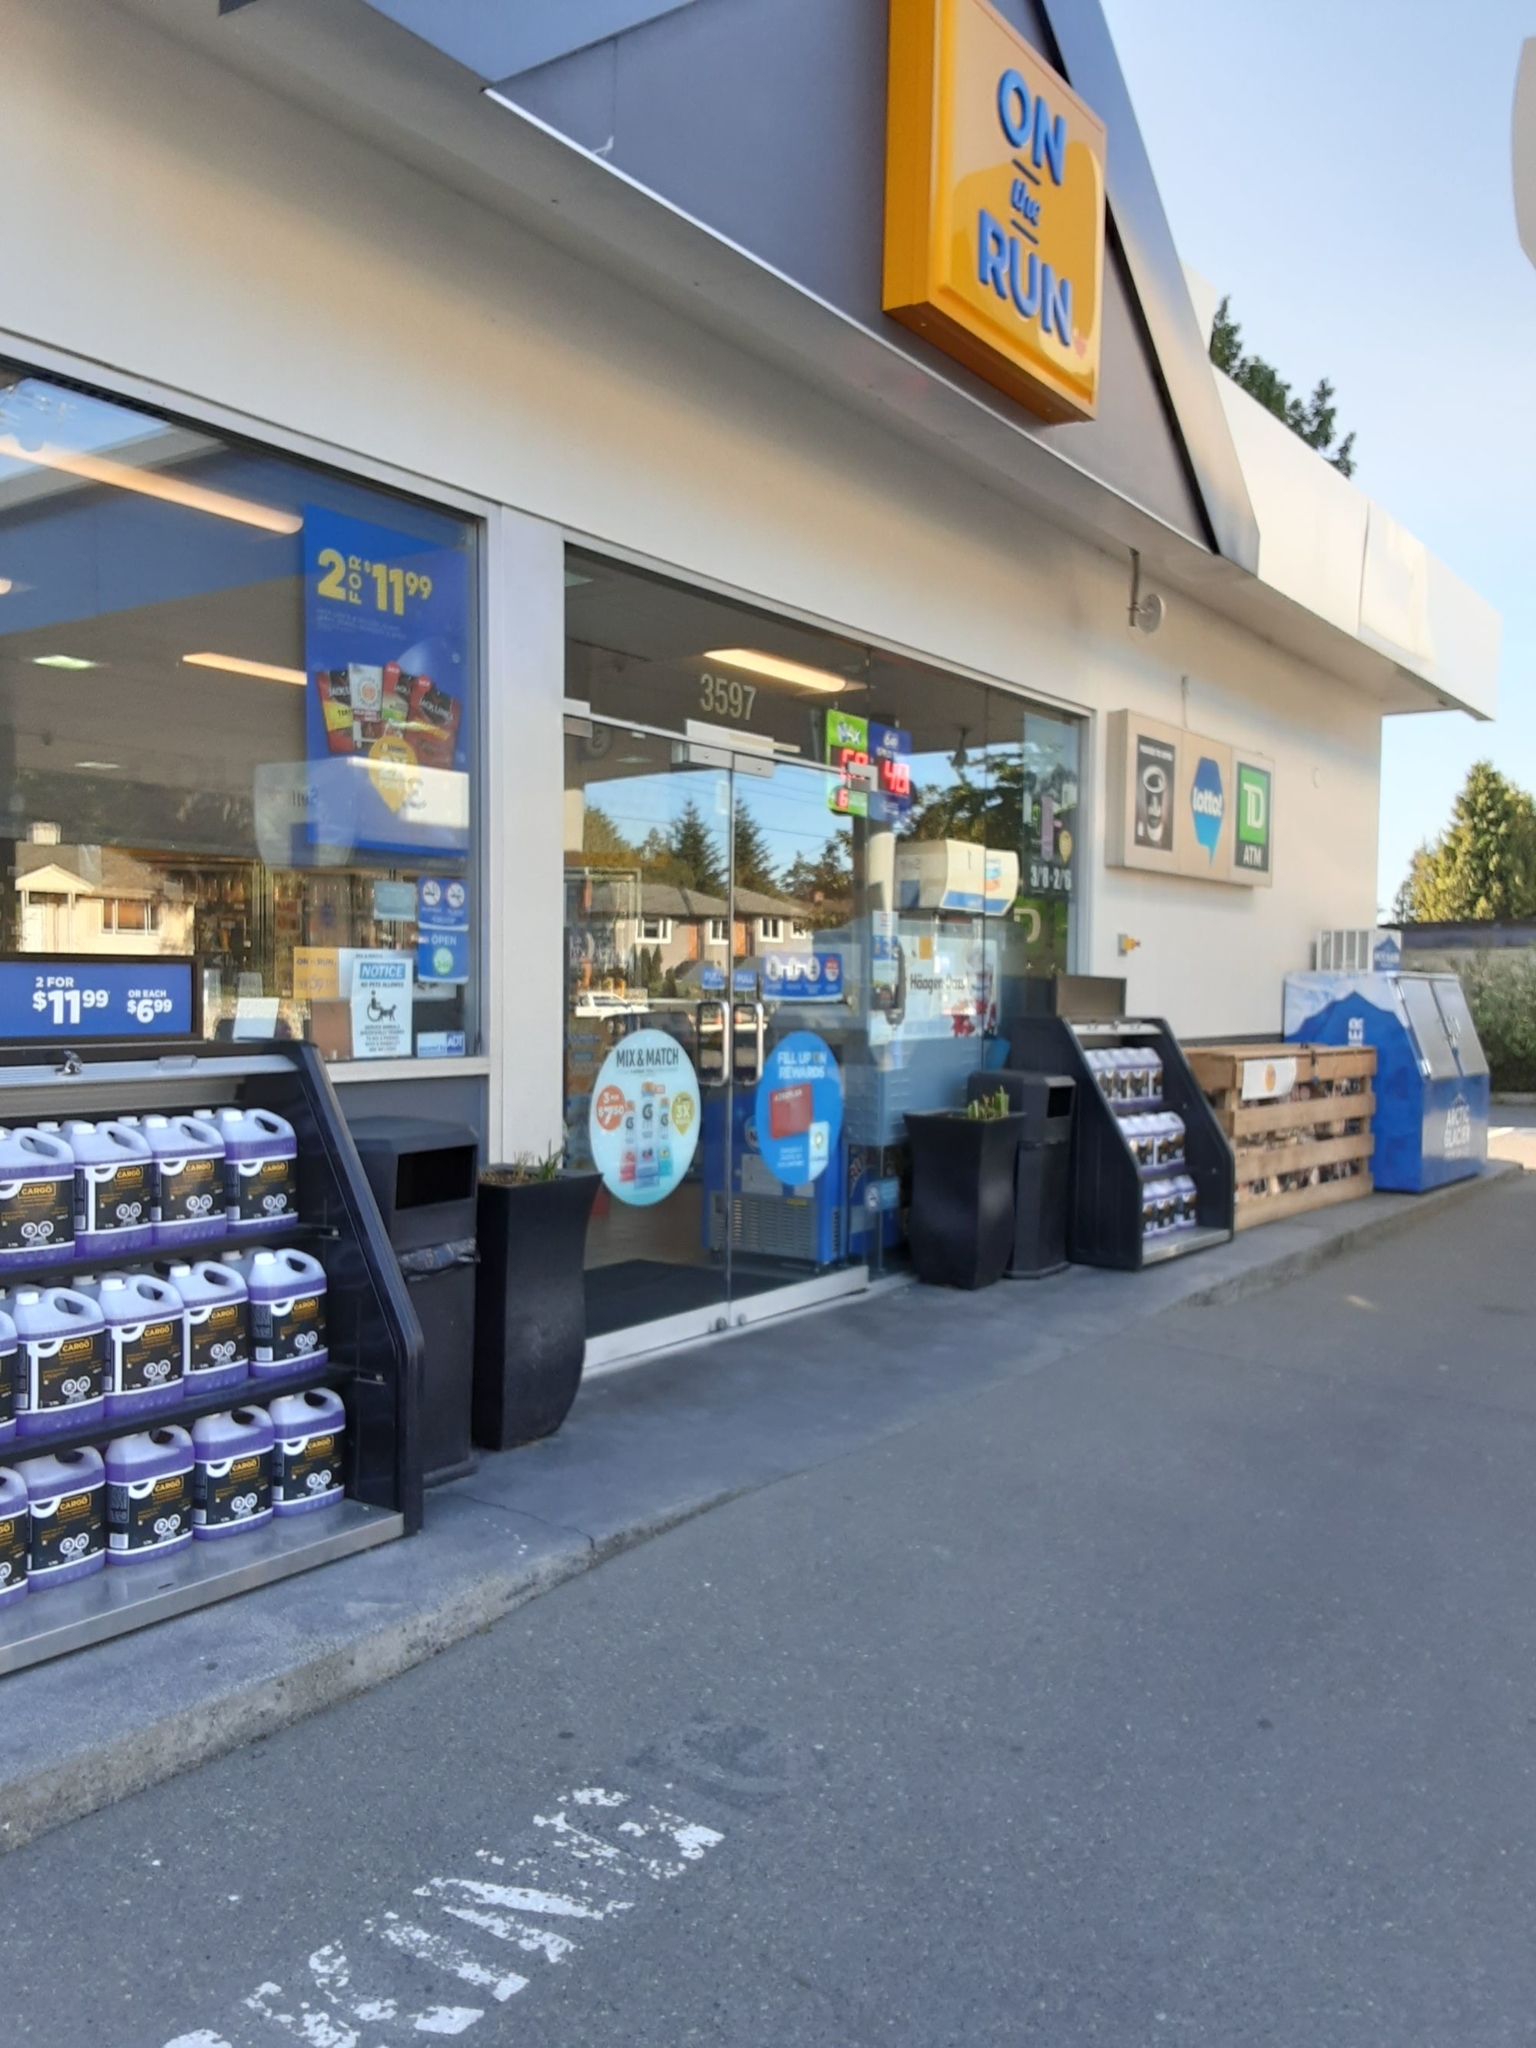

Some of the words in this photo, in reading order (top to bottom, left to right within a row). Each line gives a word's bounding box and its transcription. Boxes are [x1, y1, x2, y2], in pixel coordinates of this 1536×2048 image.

[997, 68, 1067, 186] ON
[1010, 178, 1040, 227] the
[978, 208, 1072, 347] RUN
[318, 548, 346, 601] 2
[348, 555, 362, 605] FOR
[700, 673, 756, 721] 3597
[1243, 782, 1264, 829] TD
[1243, 846, 1262, 866] ATM
[431, 935, 457, 946] OPEN
[361, 964, 404, 978] NOTICE
[736, 974, 753, 983] PULL
[36, 976, 44, 988] 2
[47, 976, 74, 988] FOR
[128, 990, 141, 998] OR
[143, 990, 167, 998] EACH
[447, 1035, 463, 1047] ADT
[616, 1049, 635, 1068] MIX
[637, 1048, 644, 1067] &
[646, 1047, 679, 1067] MATCH
[778, 1051, 797, 1065] FILL
[798, 1051, 811, 1064] UP
[778, 1065, 825, 1080] REWARDS
